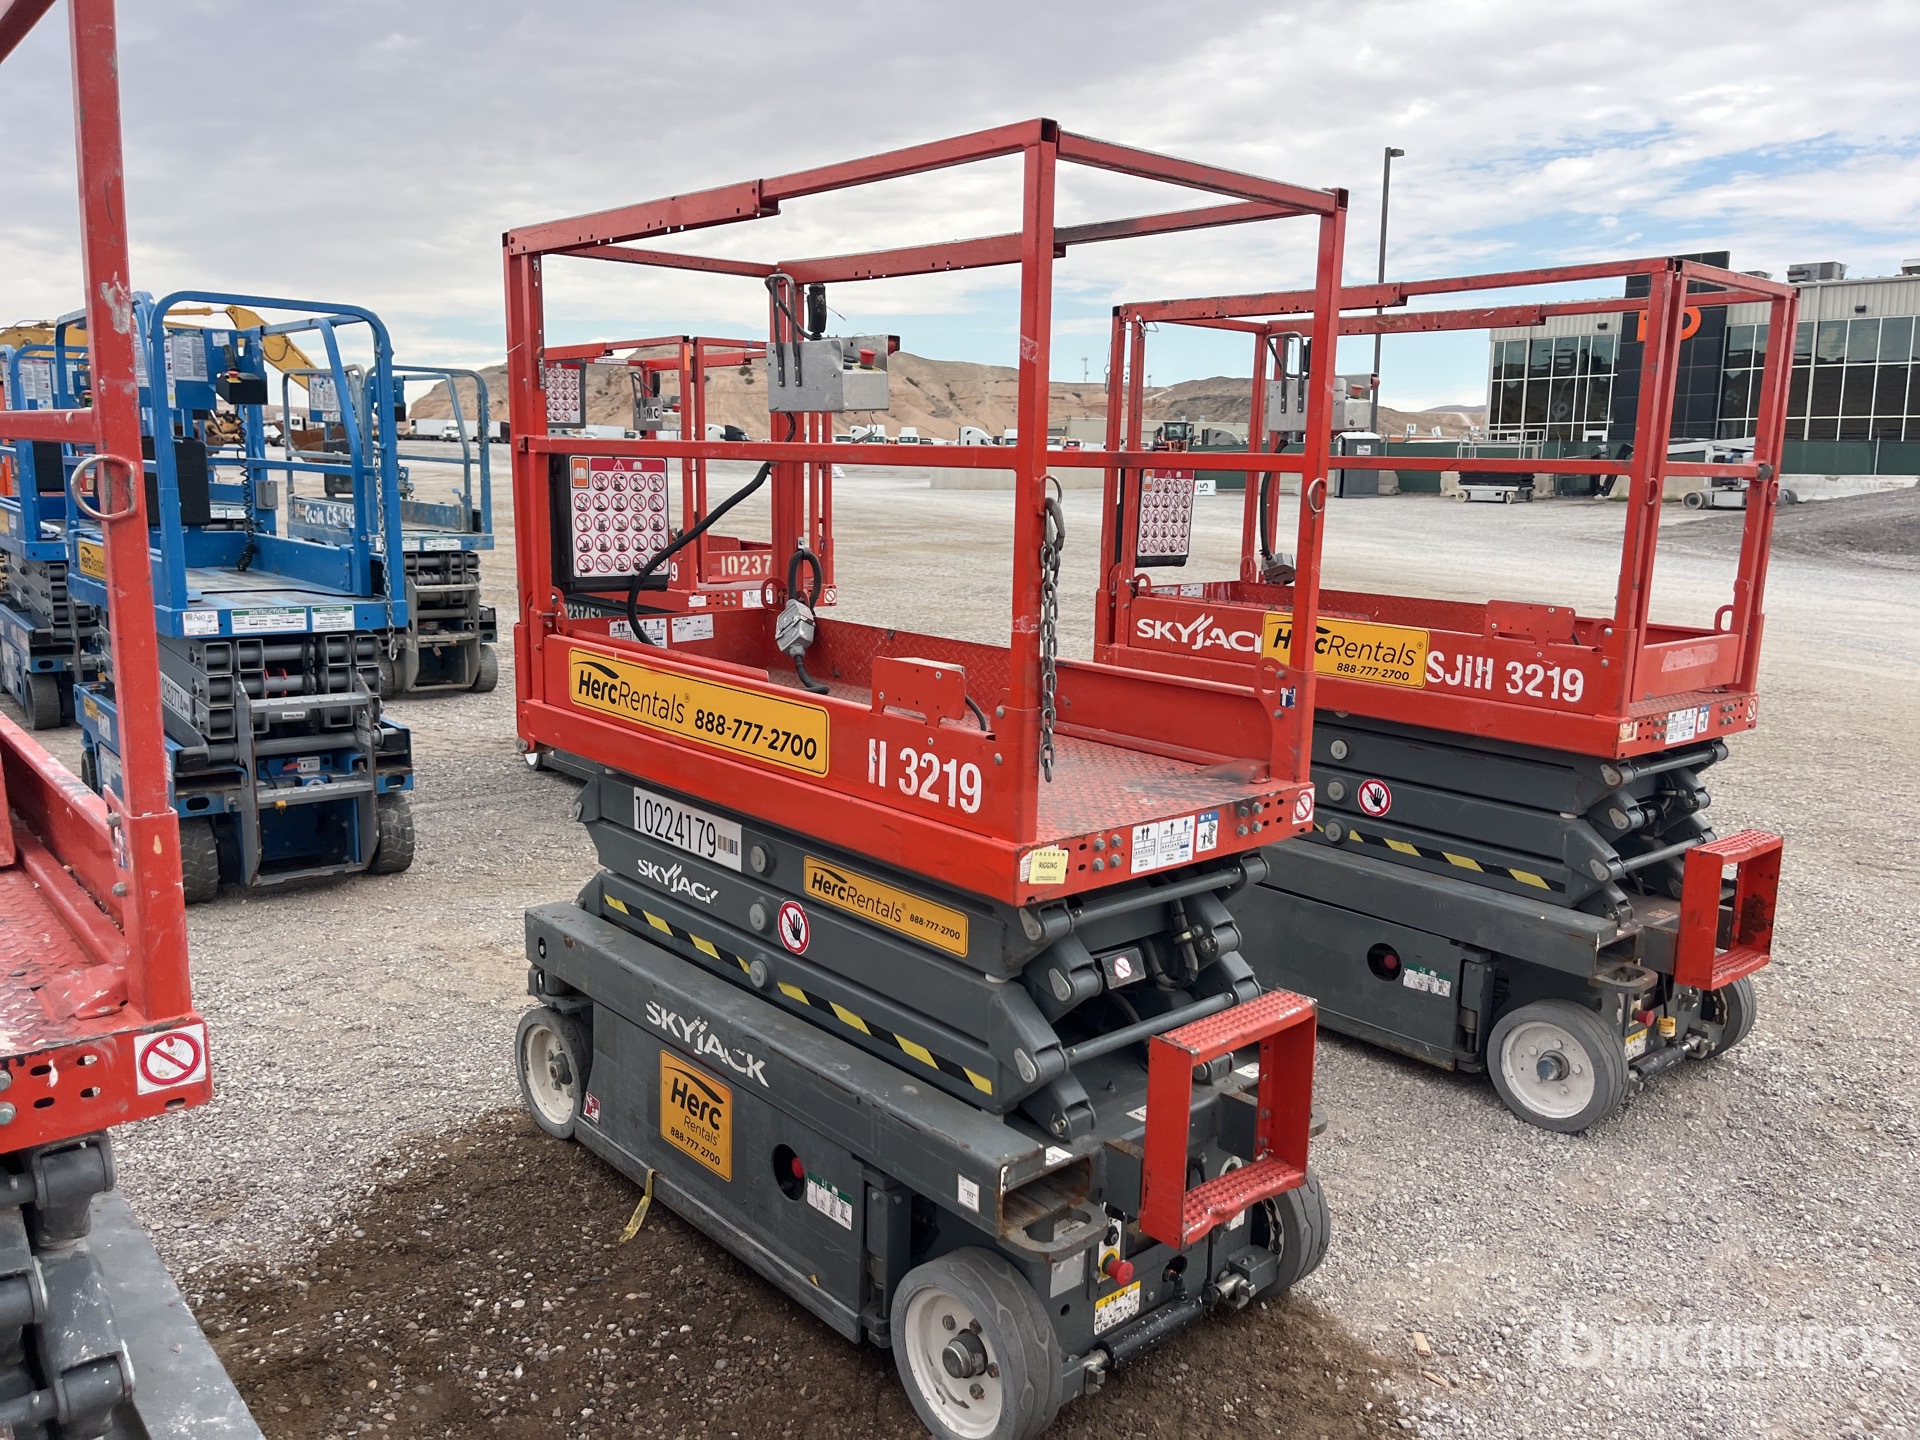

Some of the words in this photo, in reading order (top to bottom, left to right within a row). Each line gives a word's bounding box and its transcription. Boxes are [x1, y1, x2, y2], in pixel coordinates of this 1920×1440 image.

[646, 407, 659, 419] MC
[721, 554, 772, 577] 10237
[1273, 628, 1417, 667] HcRentals
[1336, 662, 1410, 682] 888-777-2700
[1505, 661, 1585, 703] 3219
[577, 669, 686, 725] HercRentals
[694, 708, 818, 762] 888-777-2700
[898, 746, 982, 814] 3219
[634, 795, 717, 859] 10224179
[811, 871, 902, 924] HercRentals
[909, 913, 961, 941] 888-777-2700
[645, 1000, 770, 1088] SKYJACK
[671, 1077, 721, 1131] Herc
[670, 1125, 721, 1167] 888-777-2700
[682, 1115, 719, 1147] Rentals
